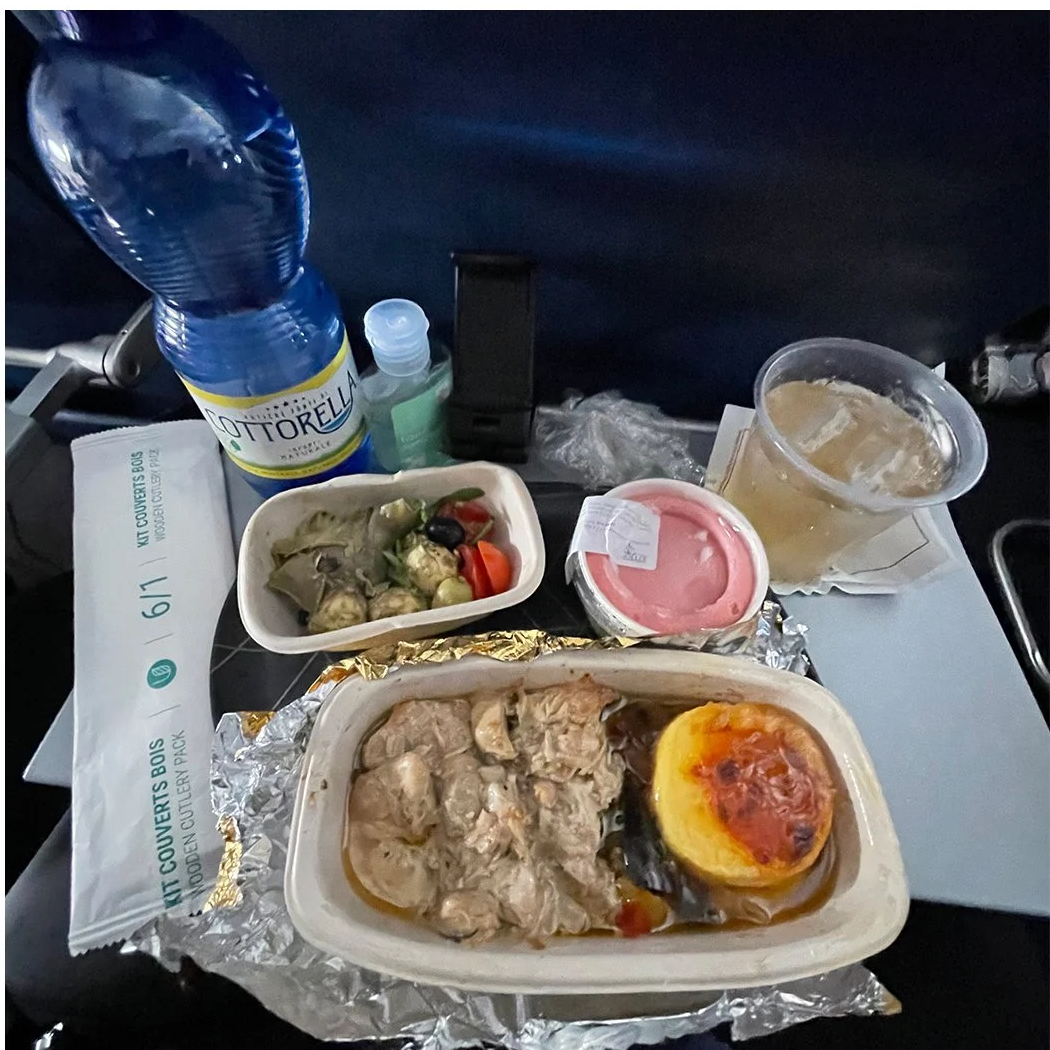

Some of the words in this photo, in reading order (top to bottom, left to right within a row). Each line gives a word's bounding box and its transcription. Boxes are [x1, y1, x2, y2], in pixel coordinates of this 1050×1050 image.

[205, 370, 357, 442] COTTORELLA
[131, 451, 144, 473] BOIS
[133, 474, 148, 528] COUVERTS
[137, 530, 149, 548] KIT
[139, 576, 172, 619] 6/1
[149, 738, 167, 778] BOIS
[171, 730, 189, 766] PACK
[175, 770, 196, 831] CUTLERY
[152, 780, 178, 875] COUVERTS
[182, 833, 206, 900] WOODEN
[161, 879, 183, 910] KIT
